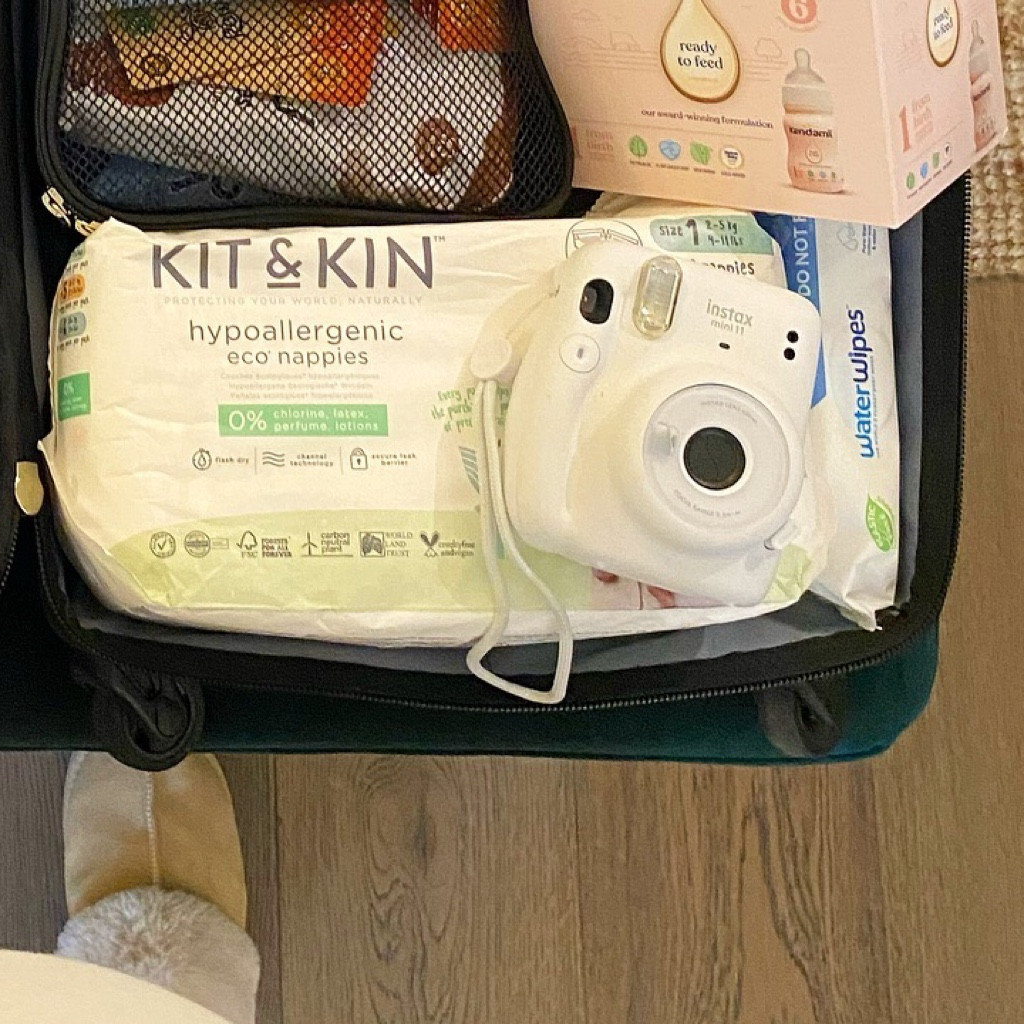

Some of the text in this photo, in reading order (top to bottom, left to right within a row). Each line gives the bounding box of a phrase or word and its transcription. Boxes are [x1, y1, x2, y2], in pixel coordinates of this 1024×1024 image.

[679, 40, 718, 57] ready
[677, 55, 724, 70] to feed
[640, 109, 656, 119] our
[721, 115, 775, 129] formulation
[684, 218, 700, 246] 1
[704, 220, 725, 231] 2-5
[793, 225, 810, 266] NOT
[152, 238, 251, 289] KIT
[266, 237, 302, 289] &
[796, 270, 813, 297] DO
[164, 296, 246, 306] PROTECTING
[252, 295, 286, 305] YOUR
[347, 295, 424, 306] NATURALLY
[706, 298, 753, 328] instax
[189, 319, 405, 346] hypoallergenic
[710, 319, 745, 336] mini 11
[278, 347, 370, 369] nappies
[228, 410, 267, 432] 0%
[272, 409, 370, 420] chlorine, latex,
[273, 421, 379, 433] perfume, lotions
[320, 531, 351, 540] carbon
[320, 538, 351, 546] neutral
